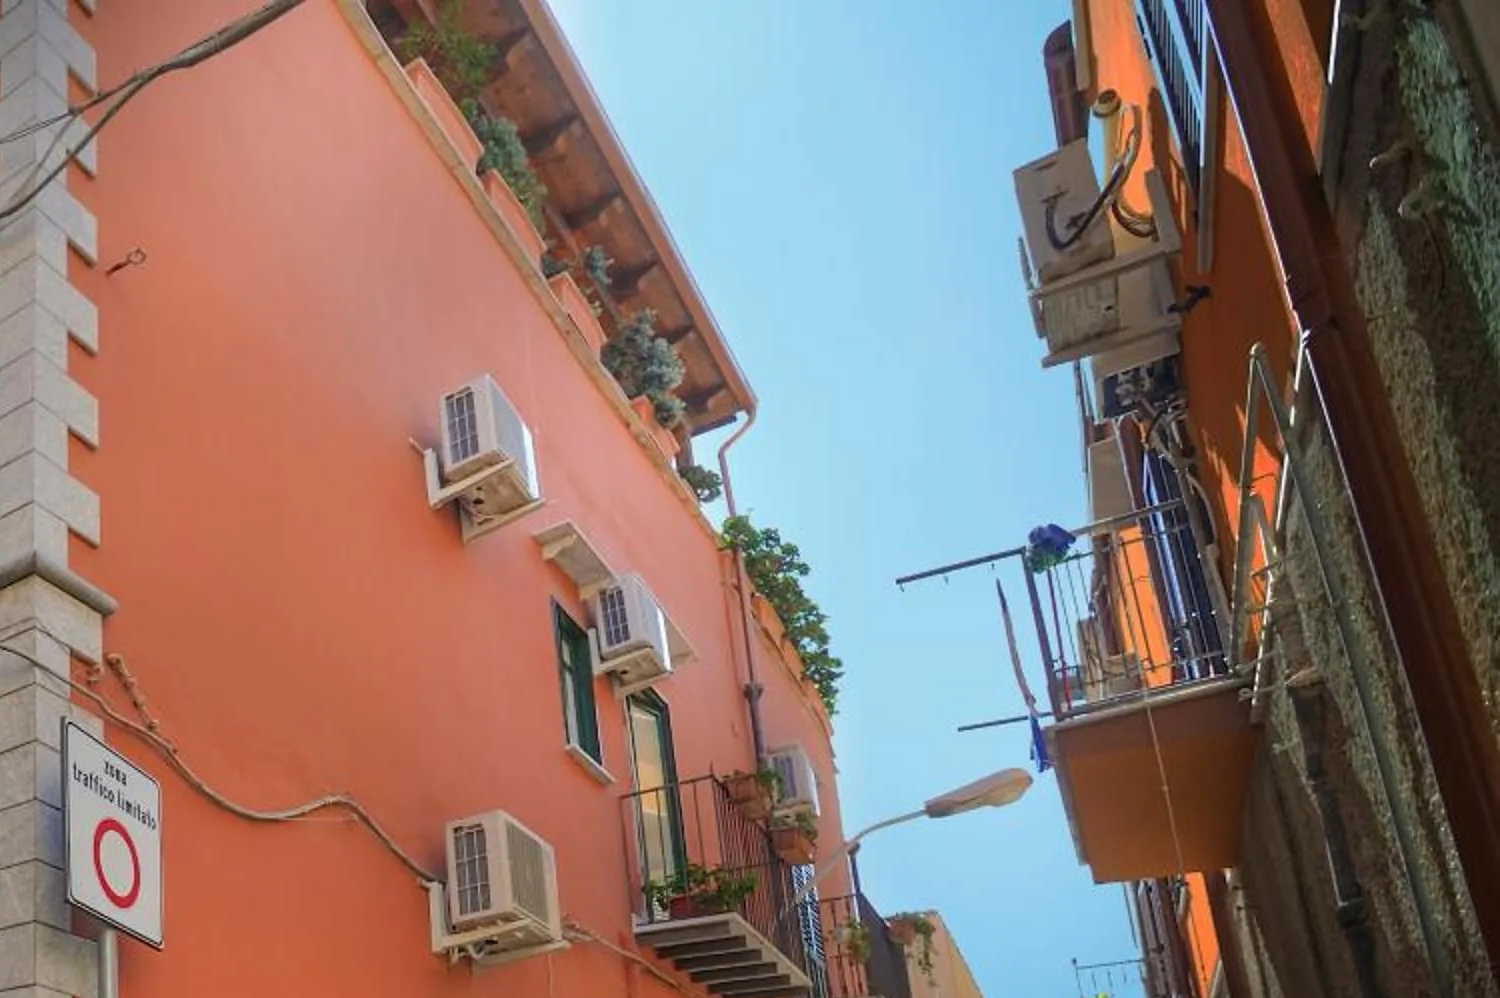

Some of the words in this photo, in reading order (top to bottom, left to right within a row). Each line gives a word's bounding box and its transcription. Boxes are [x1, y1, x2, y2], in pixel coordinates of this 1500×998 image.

[73, 761, 115, 803] traffico
[117, 789, 157, 830] limitato
[104, 761, 127, 786] zona
